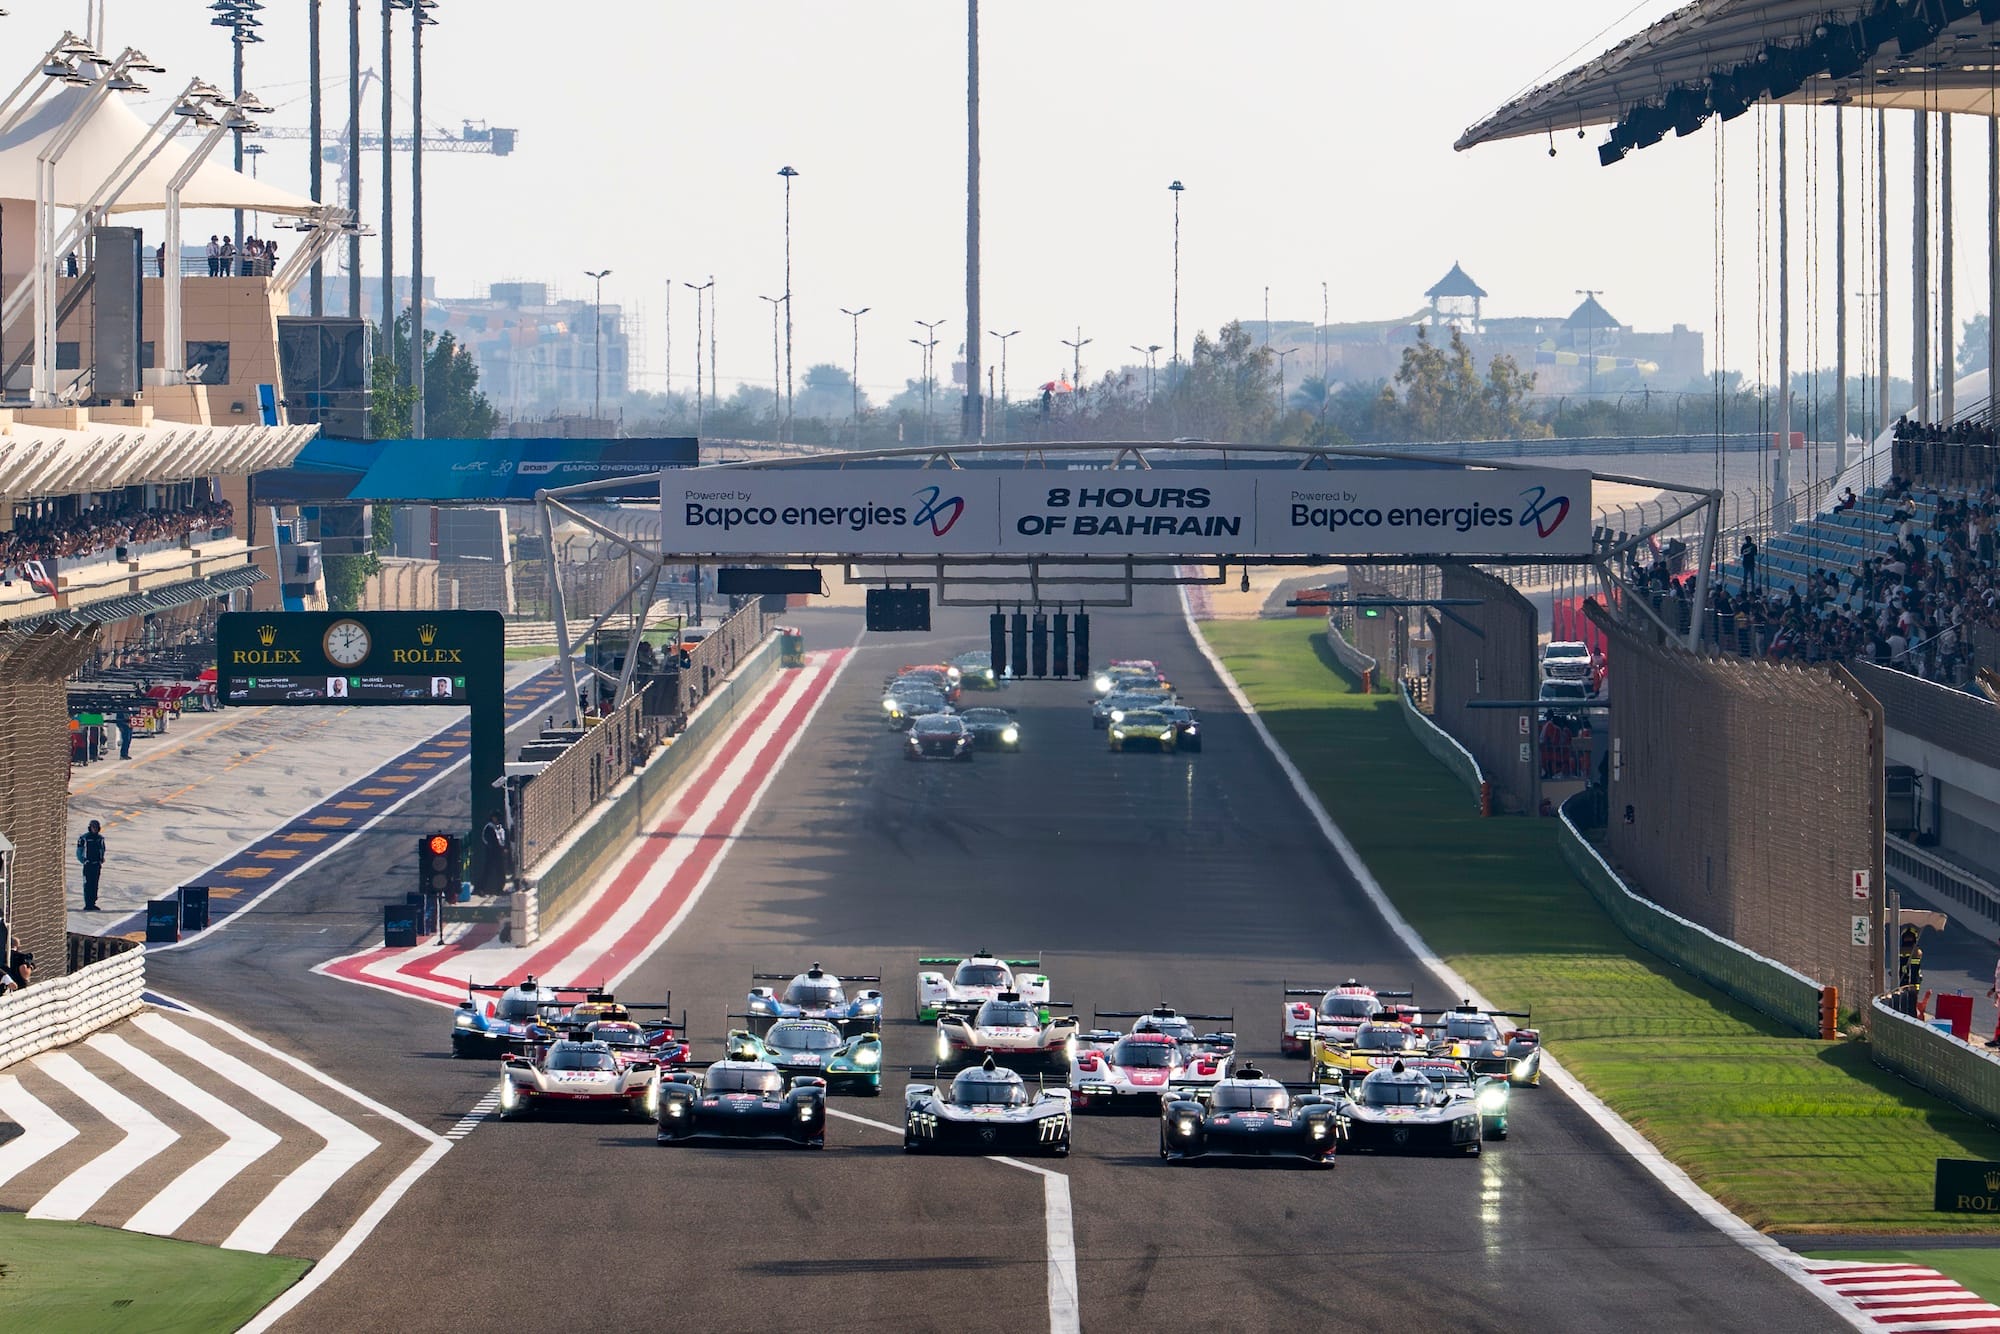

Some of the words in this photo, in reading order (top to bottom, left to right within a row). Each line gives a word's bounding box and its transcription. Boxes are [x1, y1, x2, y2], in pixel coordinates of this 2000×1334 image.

[685, 490, 734, 501] Powered
[737, 490, 752, 502] by
[1047, 488, 1070, 507] 8
[1078, 488, 1211, 508] HOURS
[1291, 490, 1340, 501] Powered
[1343, 490, 1358, 503] by
[685, 503, 777, 531] Bapco
[781, 501, 907, 531] energies
[1291, 503, 1383, 532] Bapco
[1387, 502, 1513, 532] energies
[1017, 515, 1067, 535] OF
[1073, 516, 1241, 537] BAHRAIN
[233, 650, 302, 664] ROLEX
[393, 649, 462, 663] ROLEX
[188, 696, 199, 706] 54
